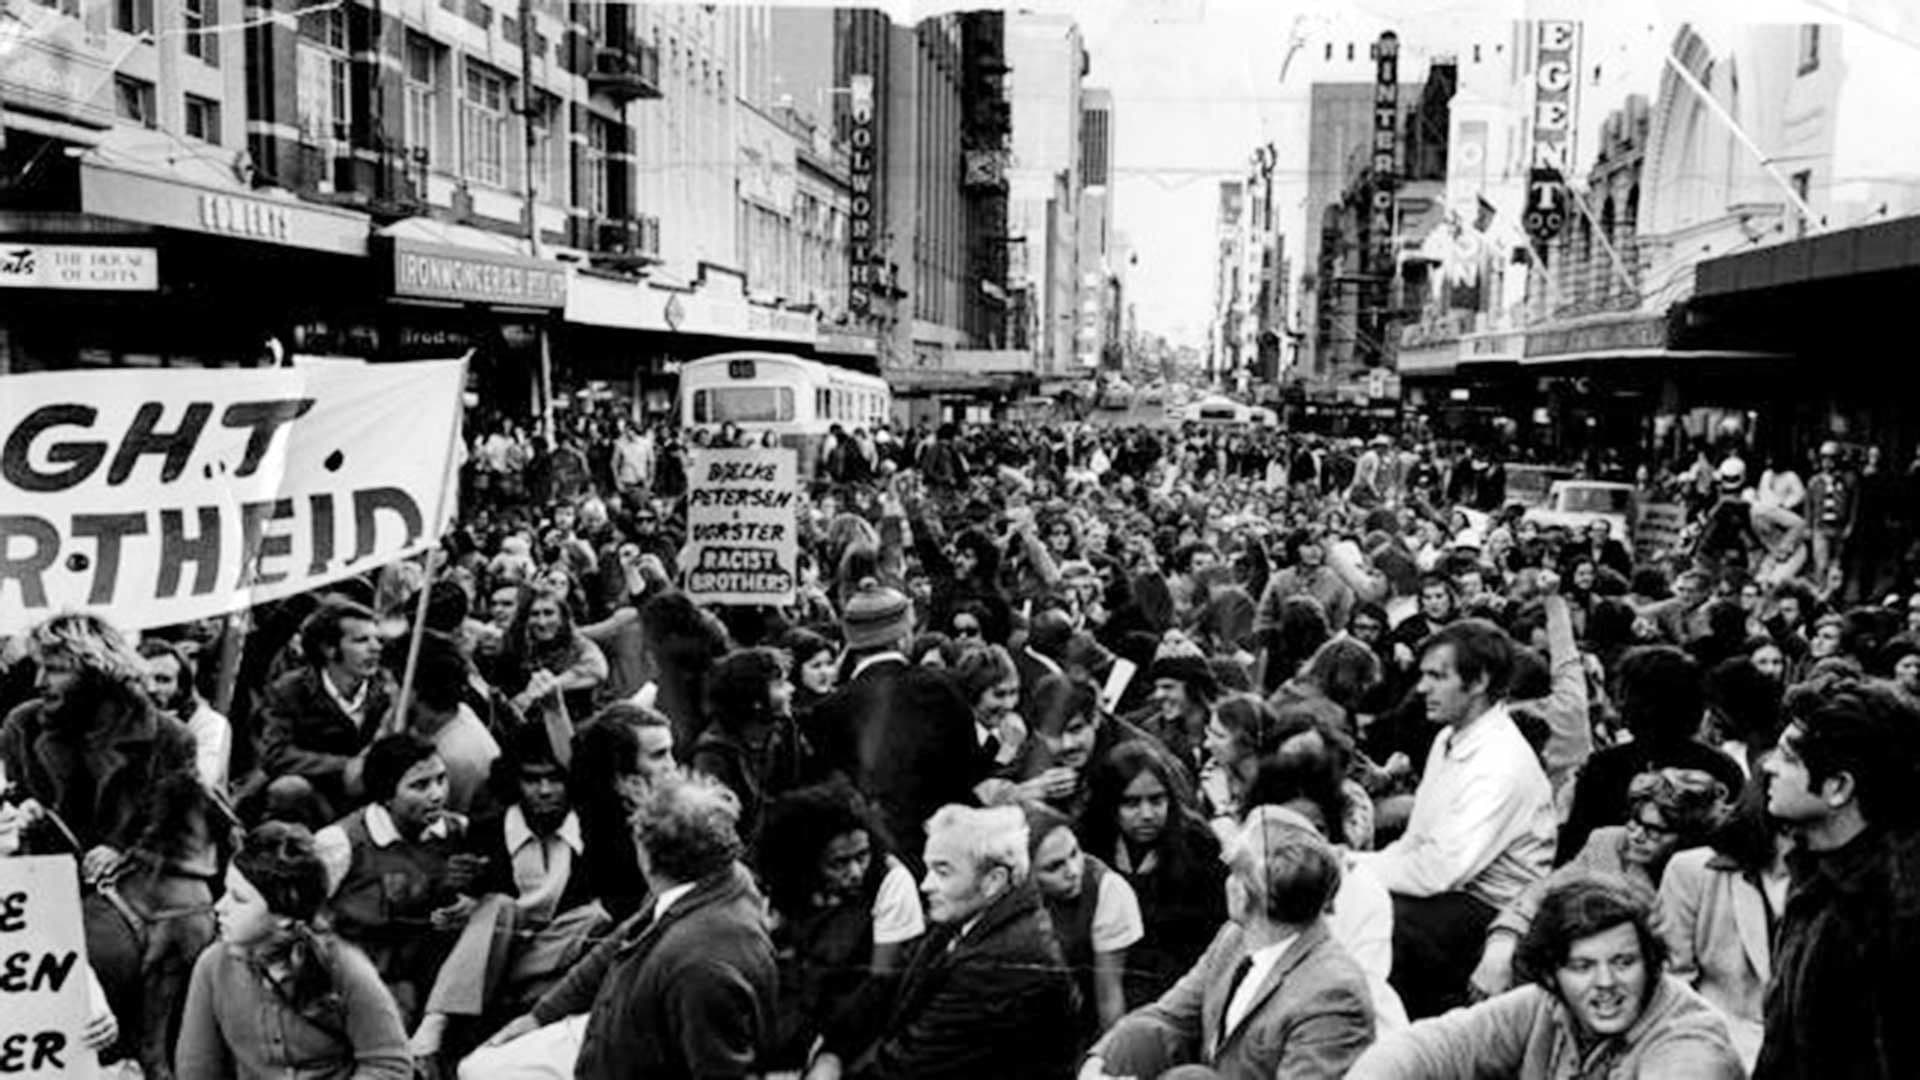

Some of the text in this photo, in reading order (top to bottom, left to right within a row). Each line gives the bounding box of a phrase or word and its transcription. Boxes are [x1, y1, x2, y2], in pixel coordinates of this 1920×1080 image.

[690, 488, 792, 508] PETERSEN
[692, 522, 785, 541] VORSTER
[702, 549, 775, 570] RACIST
[690, 570, 790, 592] BROTHERS
[0, 951, 78, 993] EN
[0, 1032, 66, 1073] ER
